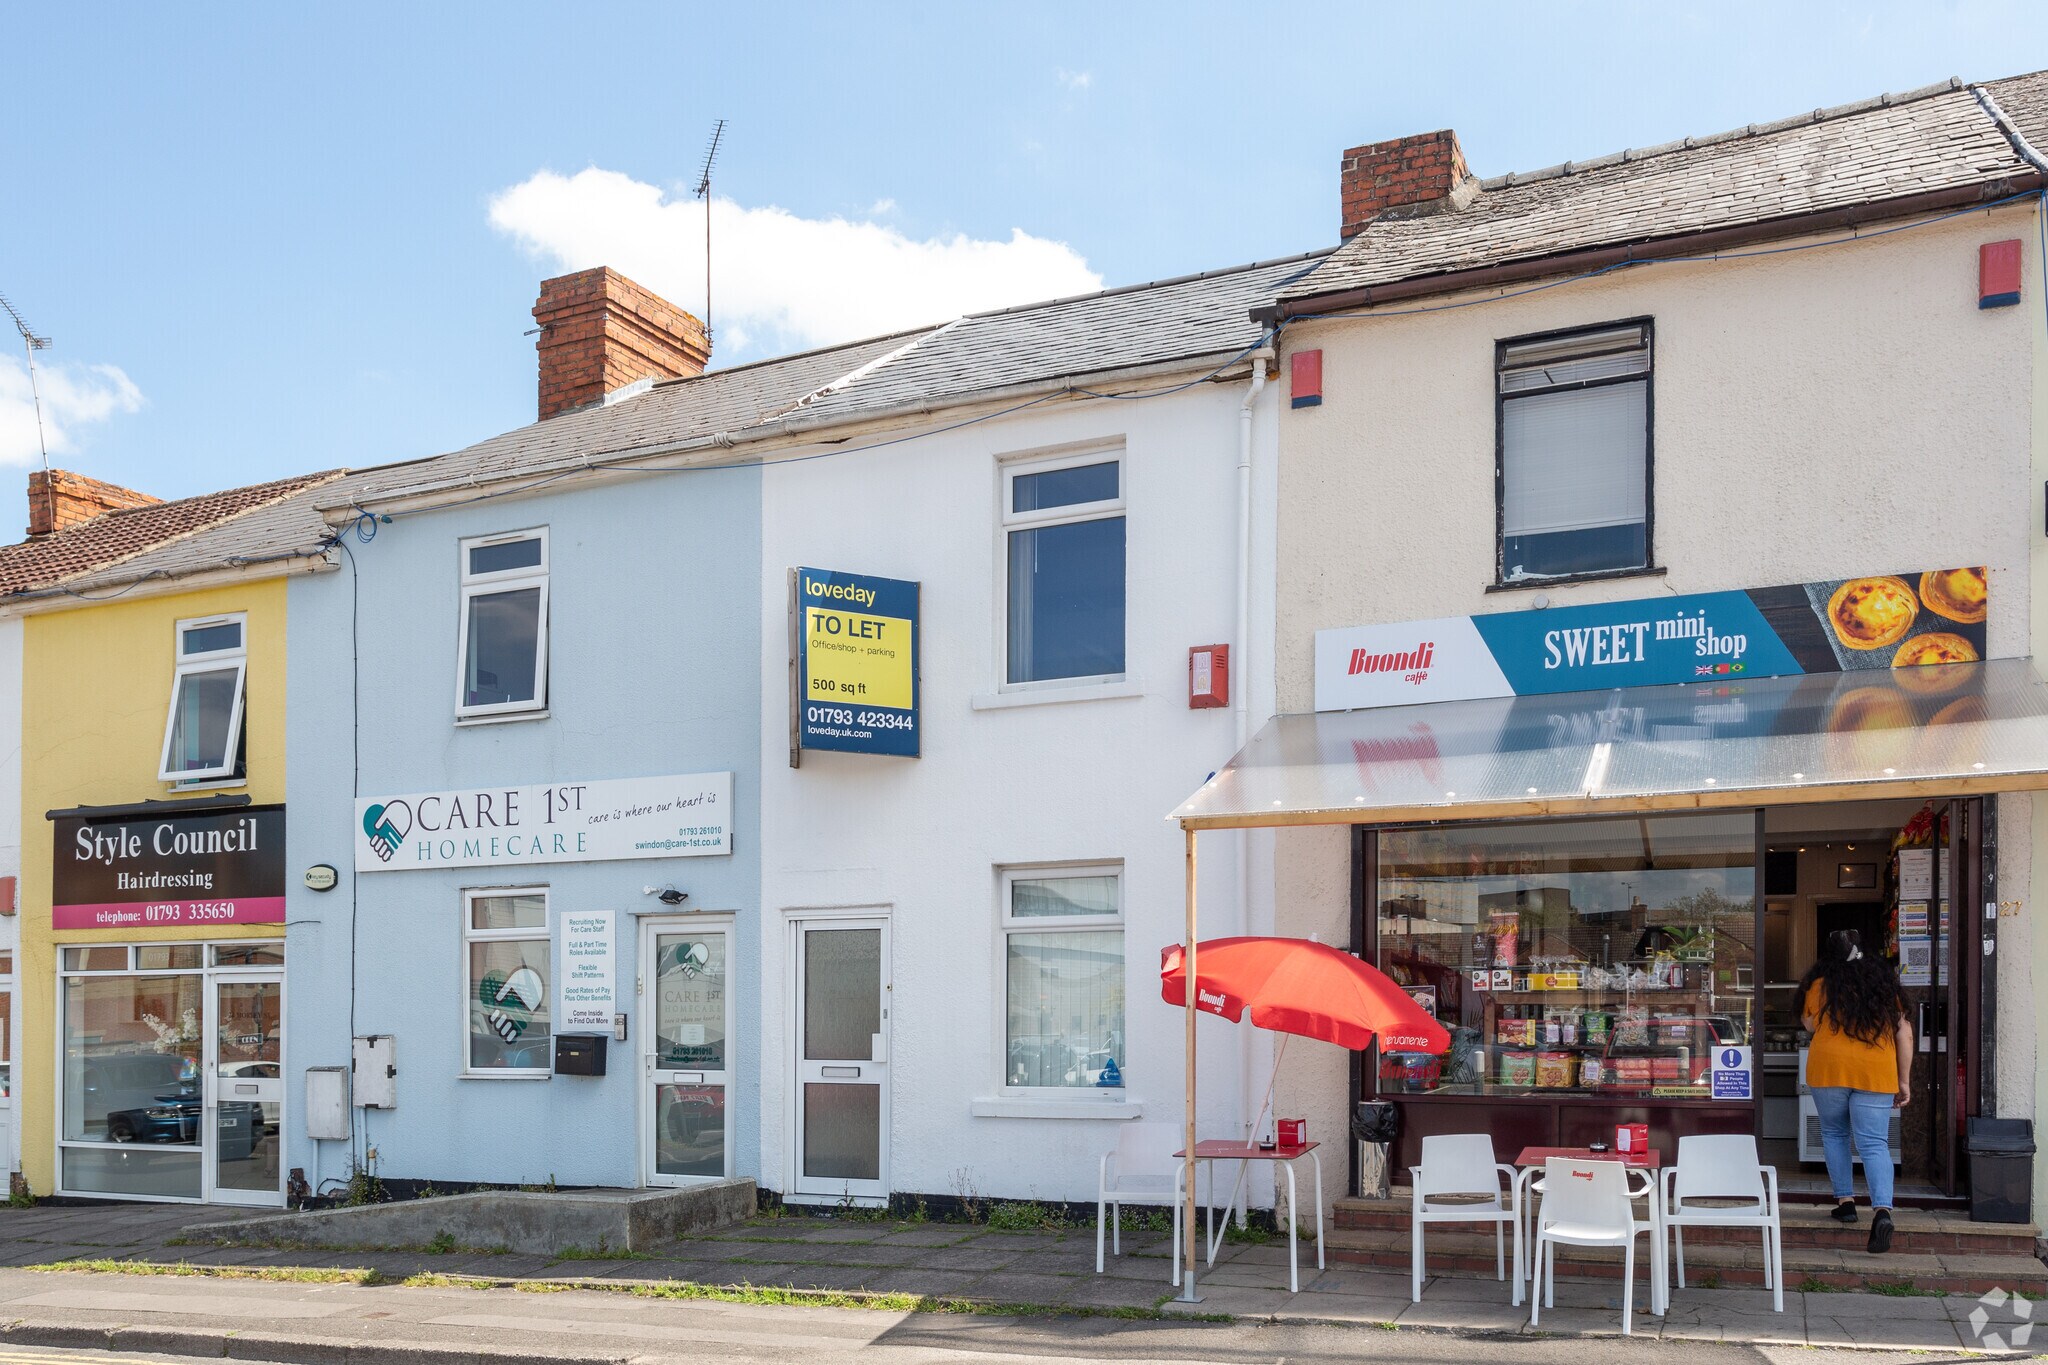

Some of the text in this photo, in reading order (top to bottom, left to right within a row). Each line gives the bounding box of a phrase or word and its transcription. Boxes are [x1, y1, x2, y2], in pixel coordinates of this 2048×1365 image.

[805, 576, 876, 607] loveday
[812, 613, 885, 640] TO LET
[811, 639, 857, 654] Office/shop
[867, 646, 895, 659] parking
[1544, 609, 1747, 669] SWEET mini shop
[1347, 642, 1434, 675] Buondi
[812, 679, 866, 696] 500 sq ft
[807, 706, 913, 731] 01793 423344
[807, 725, 872, 739] loveday.uk.com
[417, 786, 587, 832] CARE 1ST
[588, 792, 717, 825] care is where our heart is
[679, 826, 722, 836] 01793 261010
[75, 818, 258, 866] Style Council
[417, 831, 588, 861] HOMECARE
[635, 836, 722, 851] swindon@care-1st.co.uk
[117, 869, 213, 890] Hairdressing
[96, 902, 235, 923] telephone: 01793 335650
[2000, 900, 2022, 917] 27
[569, 919, 594, 927] Recruiting
[601, 987, 610, 995] Pay
[664, 990, 721, 1003] CARE 1ST
[1199, 988, 1226, 1008] Buondi
[664, 1004, 721, 1013] HOMECARE
